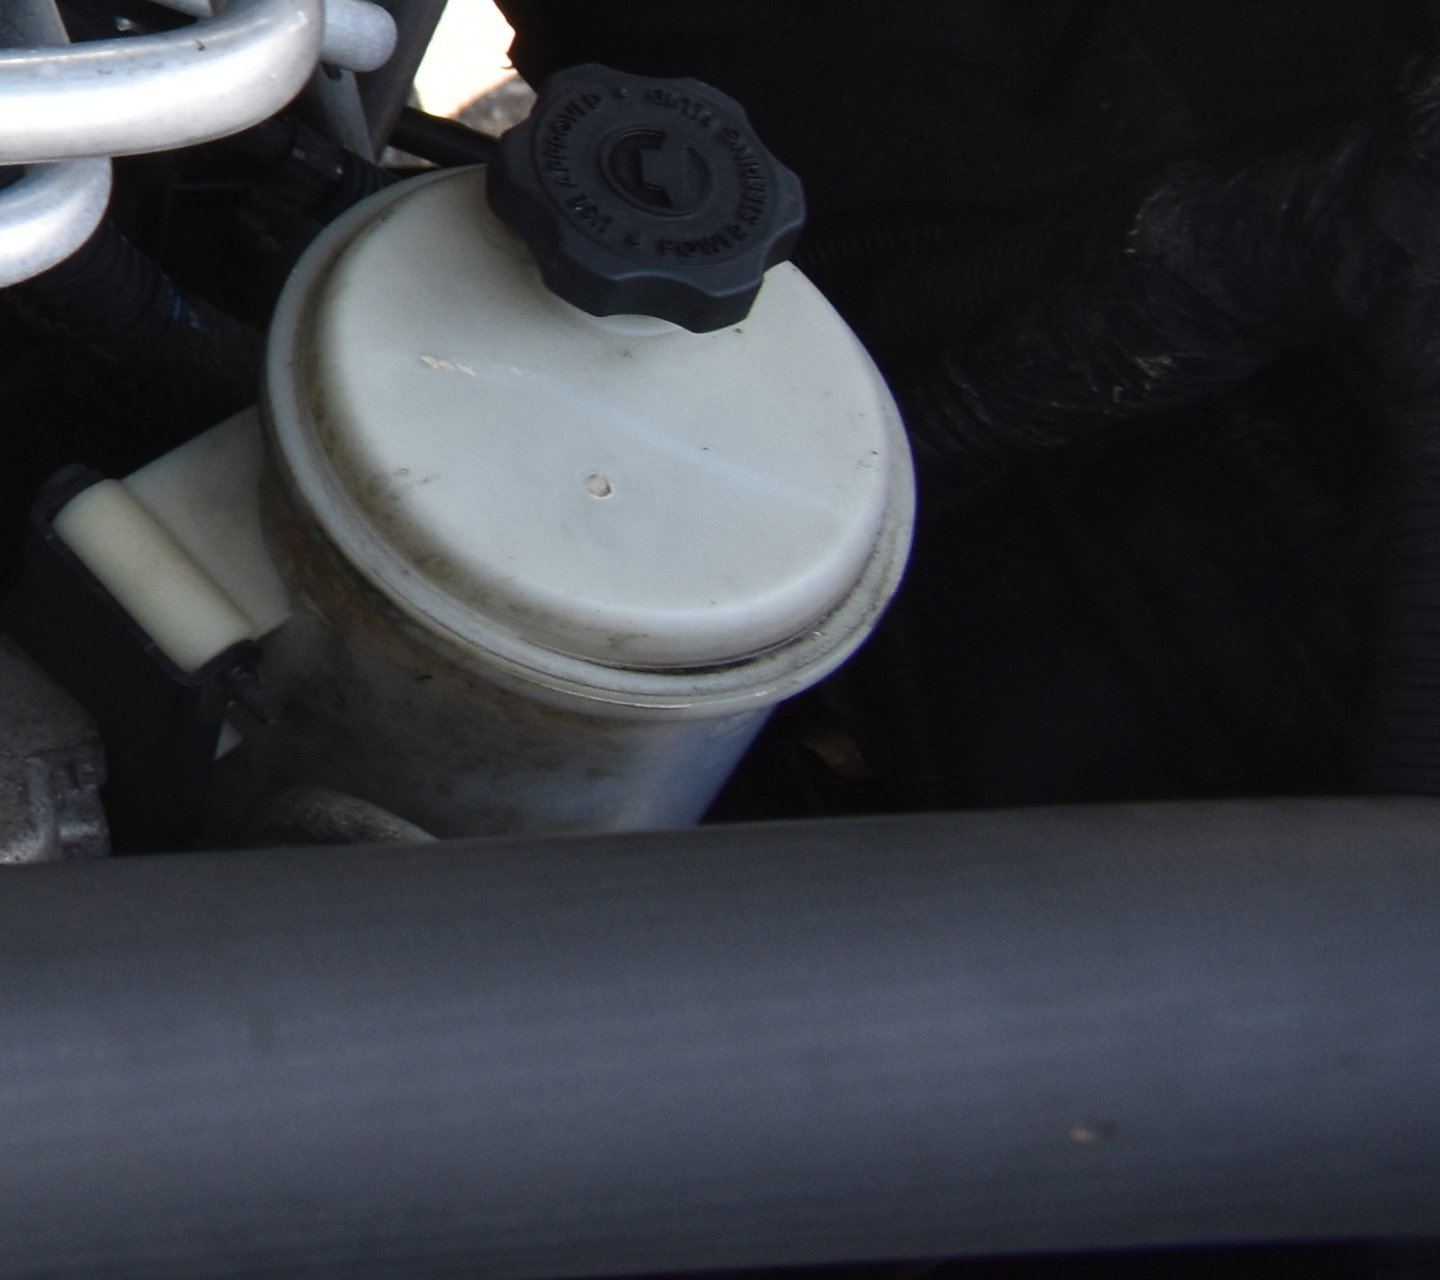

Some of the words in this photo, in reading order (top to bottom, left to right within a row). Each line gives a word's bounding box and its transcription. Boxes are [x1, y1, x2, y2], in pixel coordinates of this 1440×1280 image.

[541, 92, 602, 190] APPROVED
[656, 221, 750, 258] POWER
[719, 127, 769, 227] STEERING
